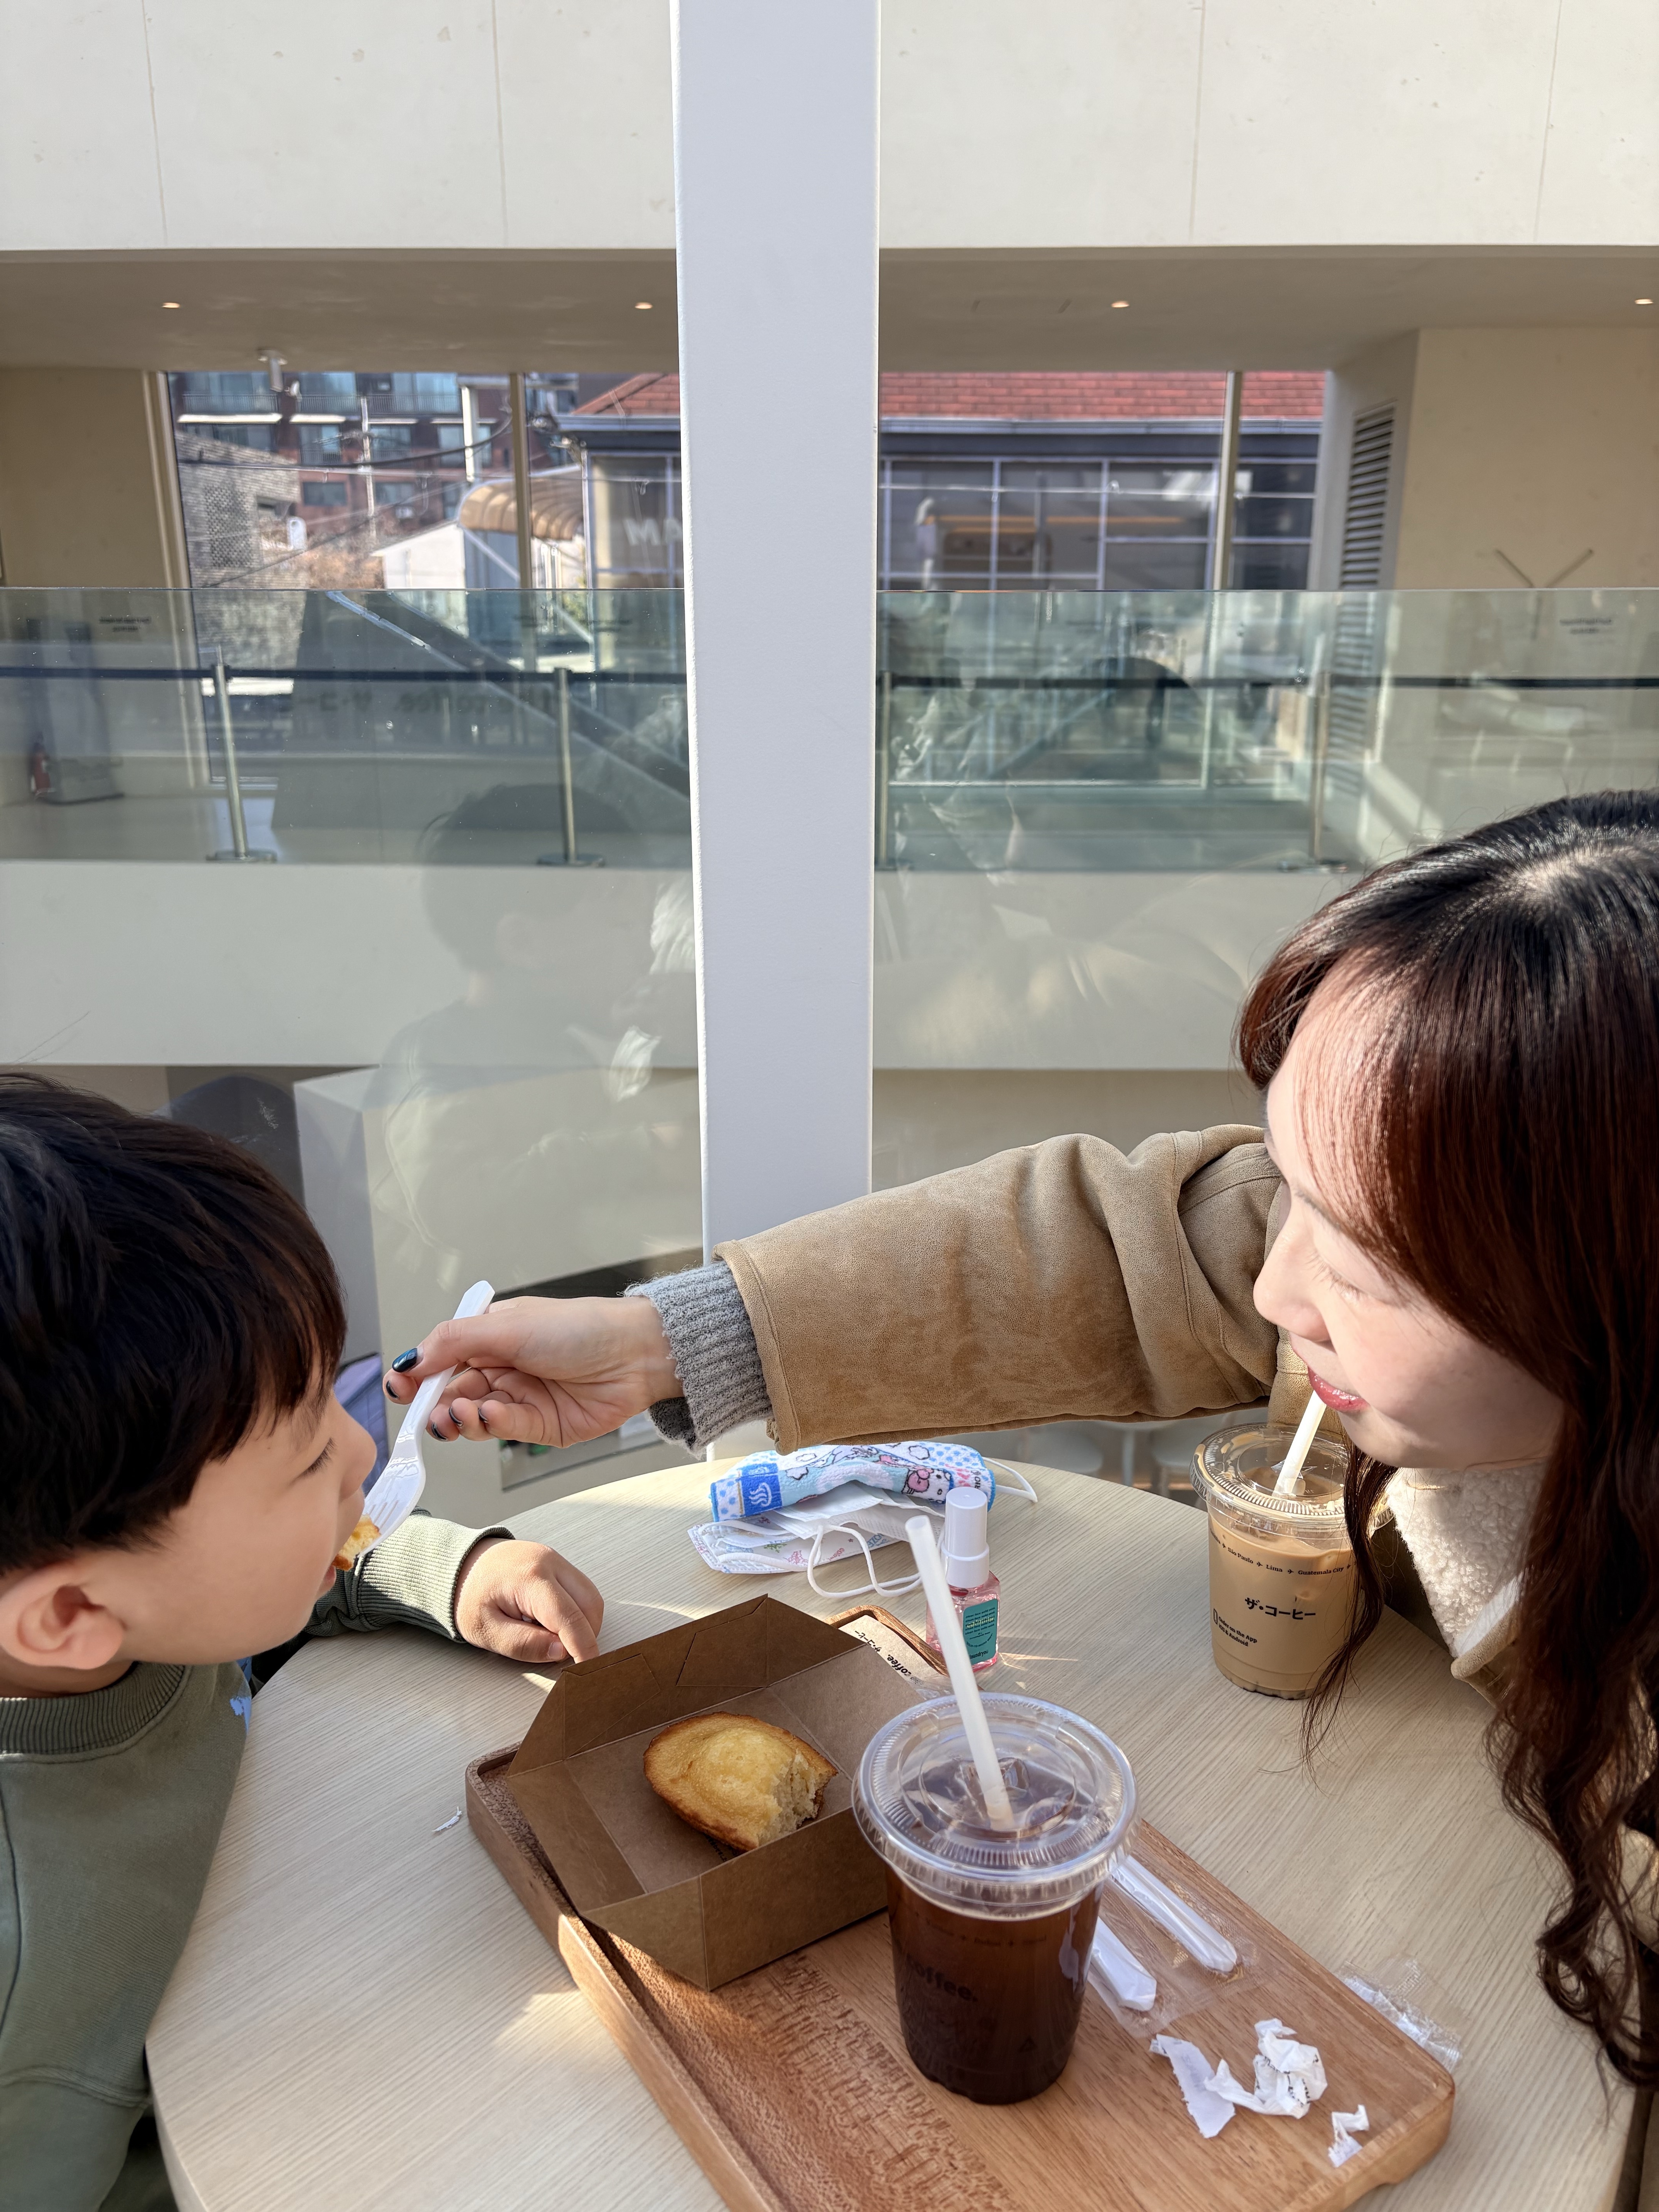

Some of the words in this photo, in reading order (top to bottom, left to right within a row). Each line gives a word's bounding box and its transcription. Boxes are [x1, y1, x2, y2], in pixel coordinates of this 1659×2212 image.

[1237, 1553, 1254, 1564] Paulo
[1245, 1597, 1316, 1620] ザ・コーヒー
[1229, 1633, 1248, 1647] Android
[1246, 1635, 1257, 1643] App
